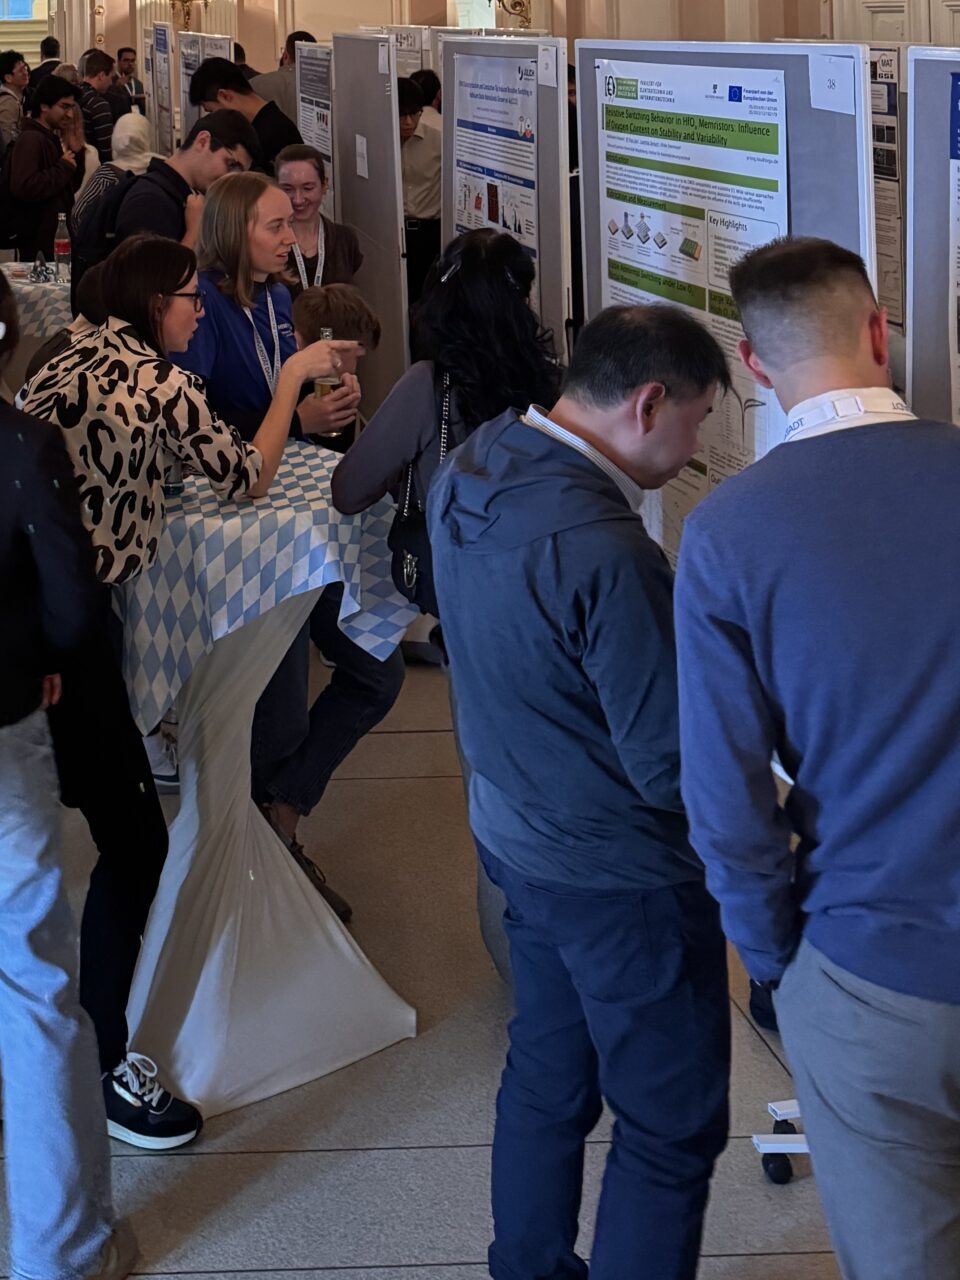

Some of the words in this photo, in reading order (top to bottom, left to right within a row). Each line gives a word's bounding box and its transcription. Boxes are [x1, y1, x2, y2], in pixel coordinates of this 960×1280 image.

[881, 58, 893, 68] MAT
[878, 72, 894, 80] GSI
[827, 78, 836, 90] 38
[625, 109, 649, 123] Switching
[650, 113, 675, 126] Behavior
[676, 116, 682, 126] in
[738, 123, 771, 137] Influence
[629, 122, 650, 135] Content
[651, 127, 659, 136] on
[659, 126, 682, 141] Stability
[683, 130, 695, 141] and
[696, 131, 728, 147] Variability
[709, 216, 719, 227] Key
[719, 216, 748, 232] Highlights
